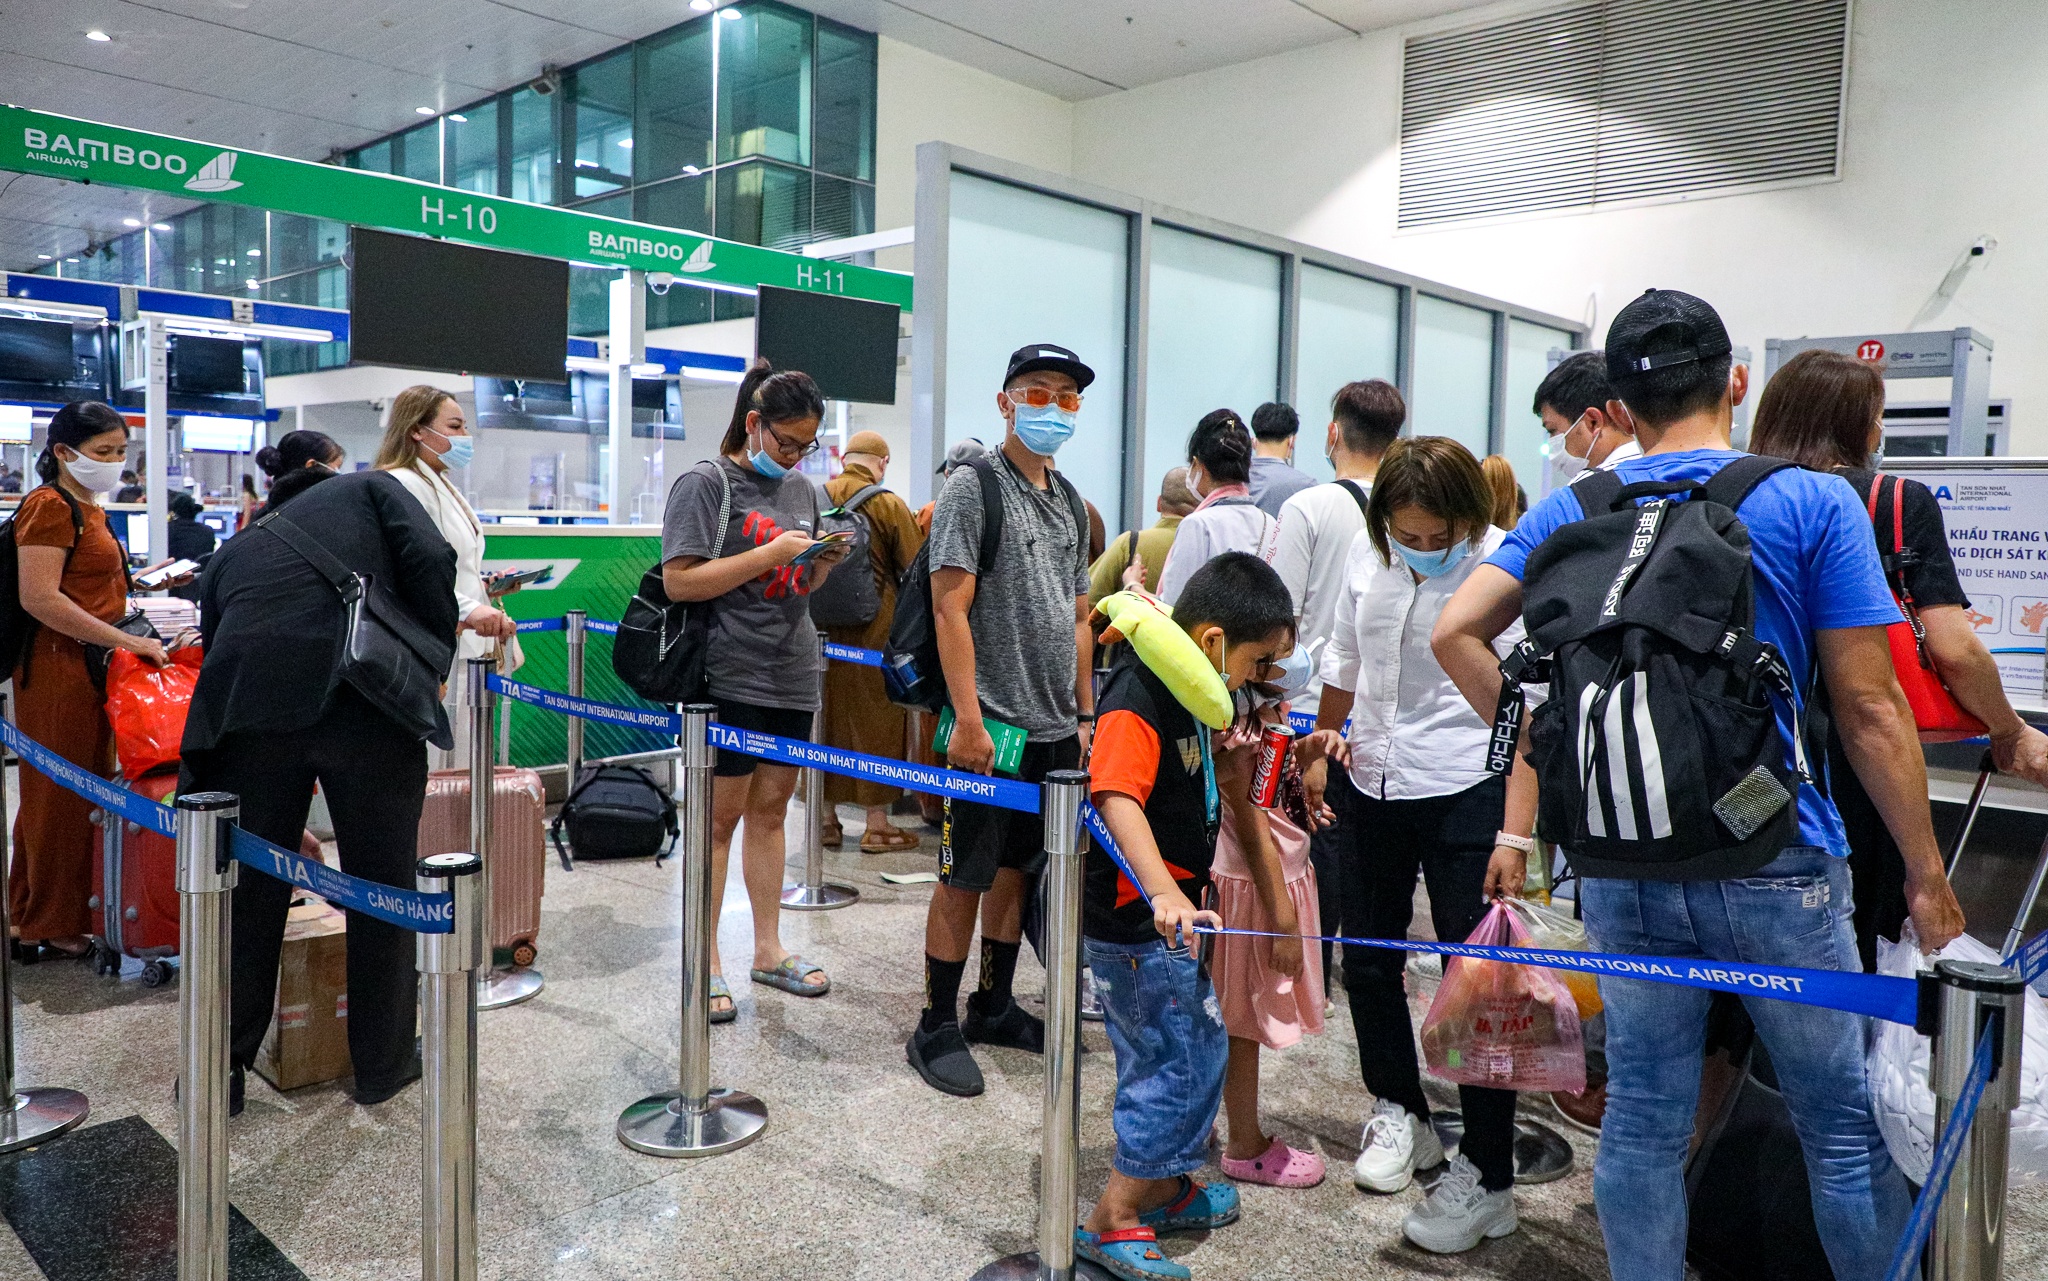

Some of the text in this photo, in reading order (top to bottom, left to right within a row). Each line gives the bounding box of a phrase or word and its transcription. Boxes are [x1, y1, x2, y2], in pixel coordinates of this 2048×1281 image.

[24, 127, 187, 175] BAMBOO
[26, 151, 89, 169] AIRWAYS
[421, 196, 497, 234] H-10
[588, 230, 683, 261] BAMBOO
[589, 248, 626, 260] AIRWAYS
[797, 264, 845, 292] H-11
[1861, 344, 1880, 360] 17
[1950, 526, 1988, 541] KHẨU
[1992, 530, 2040, 542] TRANG
[1949, 547, 1966, 558] NG
[1970, 548, 2003, 560] DỊCH
[2007, 547, 2033, 560] SÁT
[1975, 569, 1994, 578] USE
[1997, 570, 2027, 579] HAND
[1603, 563, 1637, 615] ADIDAS
[500, 679, 521, 699] TIA
[544, 694, 670, 728] TAN SON NHAT INTERNATIONAL AIRPORT
[3, 723, 18, 750] TIA
[708, 726, 741, 749] TIA
[746, 739, 778, 751] INTERNATIONAL
[764, 735, 776, 743] NHAT
[1491, 700, 1520, 771] 아디다스
[746, 746, 765, 754] AIRPORT
[787, 744, 997, 798] TAN SON NHAT INTERNATIONAL AIRPORT
[268, 848, 315, 889] TIA
[367, 887, 453, 921] CẢNG HÀNG
[1391, 941, 1434, 951] SON
[1437, 945, 1491, 957] NHAT
[1495, 949, 1683, 979] INTERNATIONAL
[1688, 967, 1805, 993] AIRPORT
